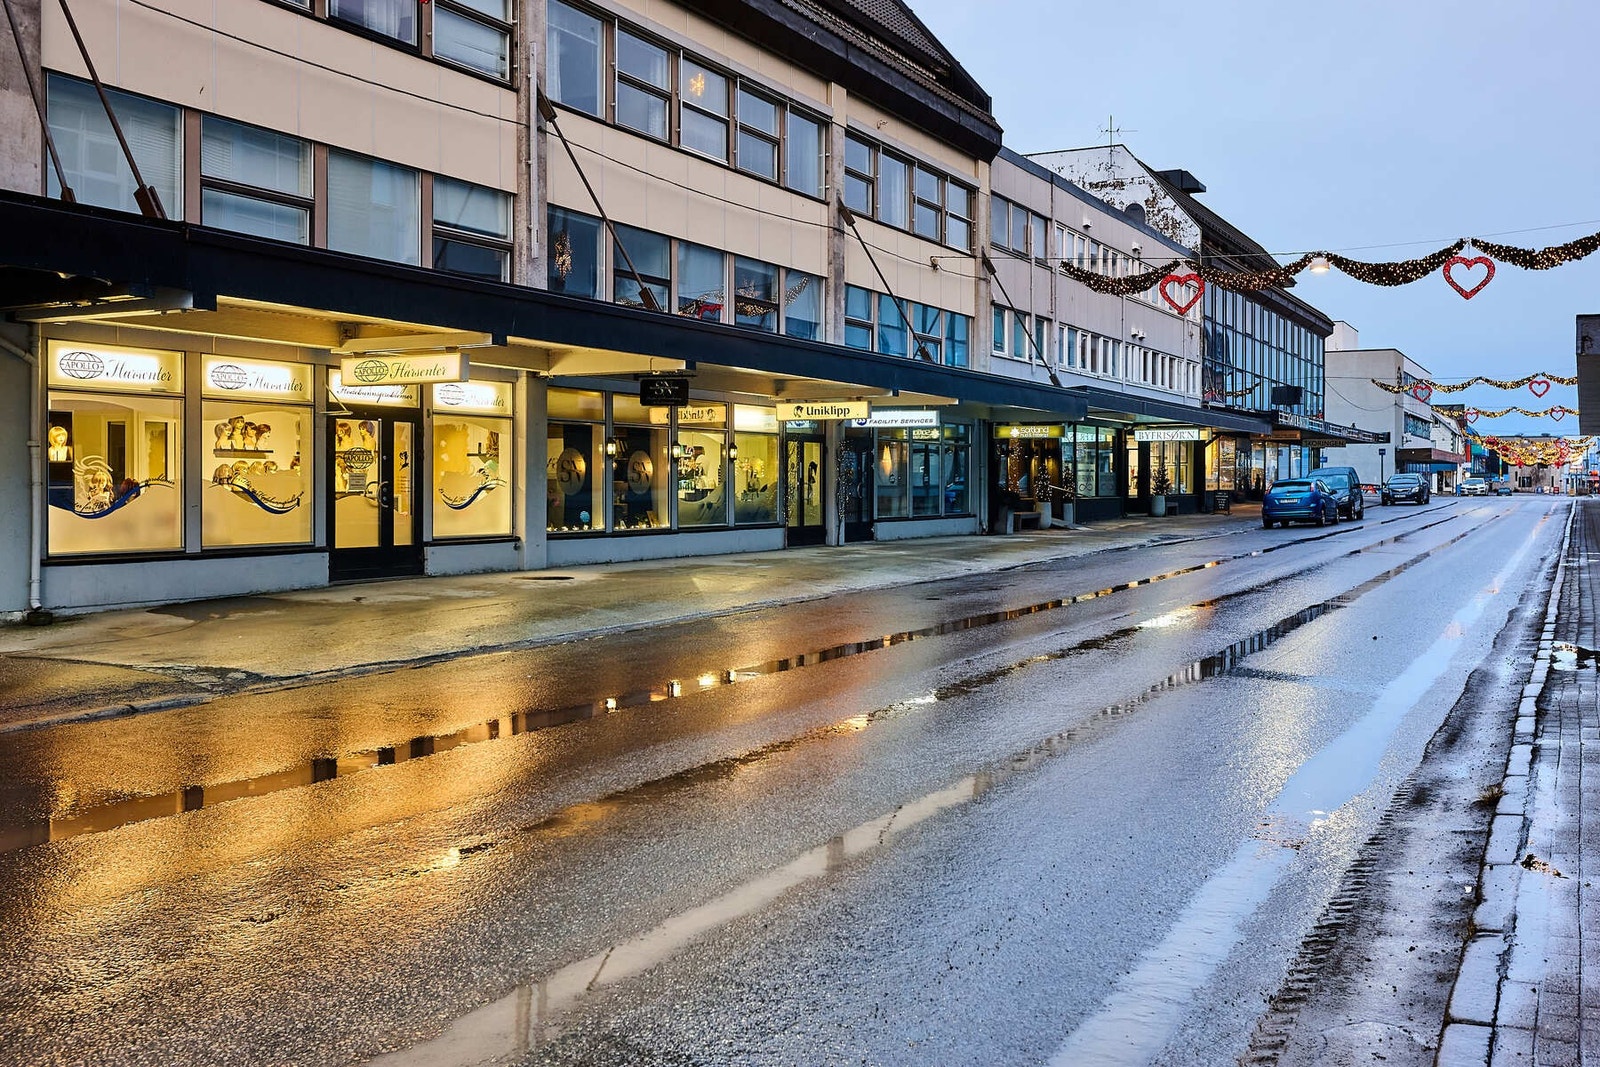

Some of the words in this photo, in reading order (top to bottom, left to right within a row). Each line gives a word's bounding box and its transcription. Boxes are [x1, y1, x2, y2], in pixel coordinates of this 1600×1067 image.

[65, 361, 100, 370] APOLLO
[358, 367, 385, 376] APOLLO
[806, 406, 851, 417] Uniklipp
